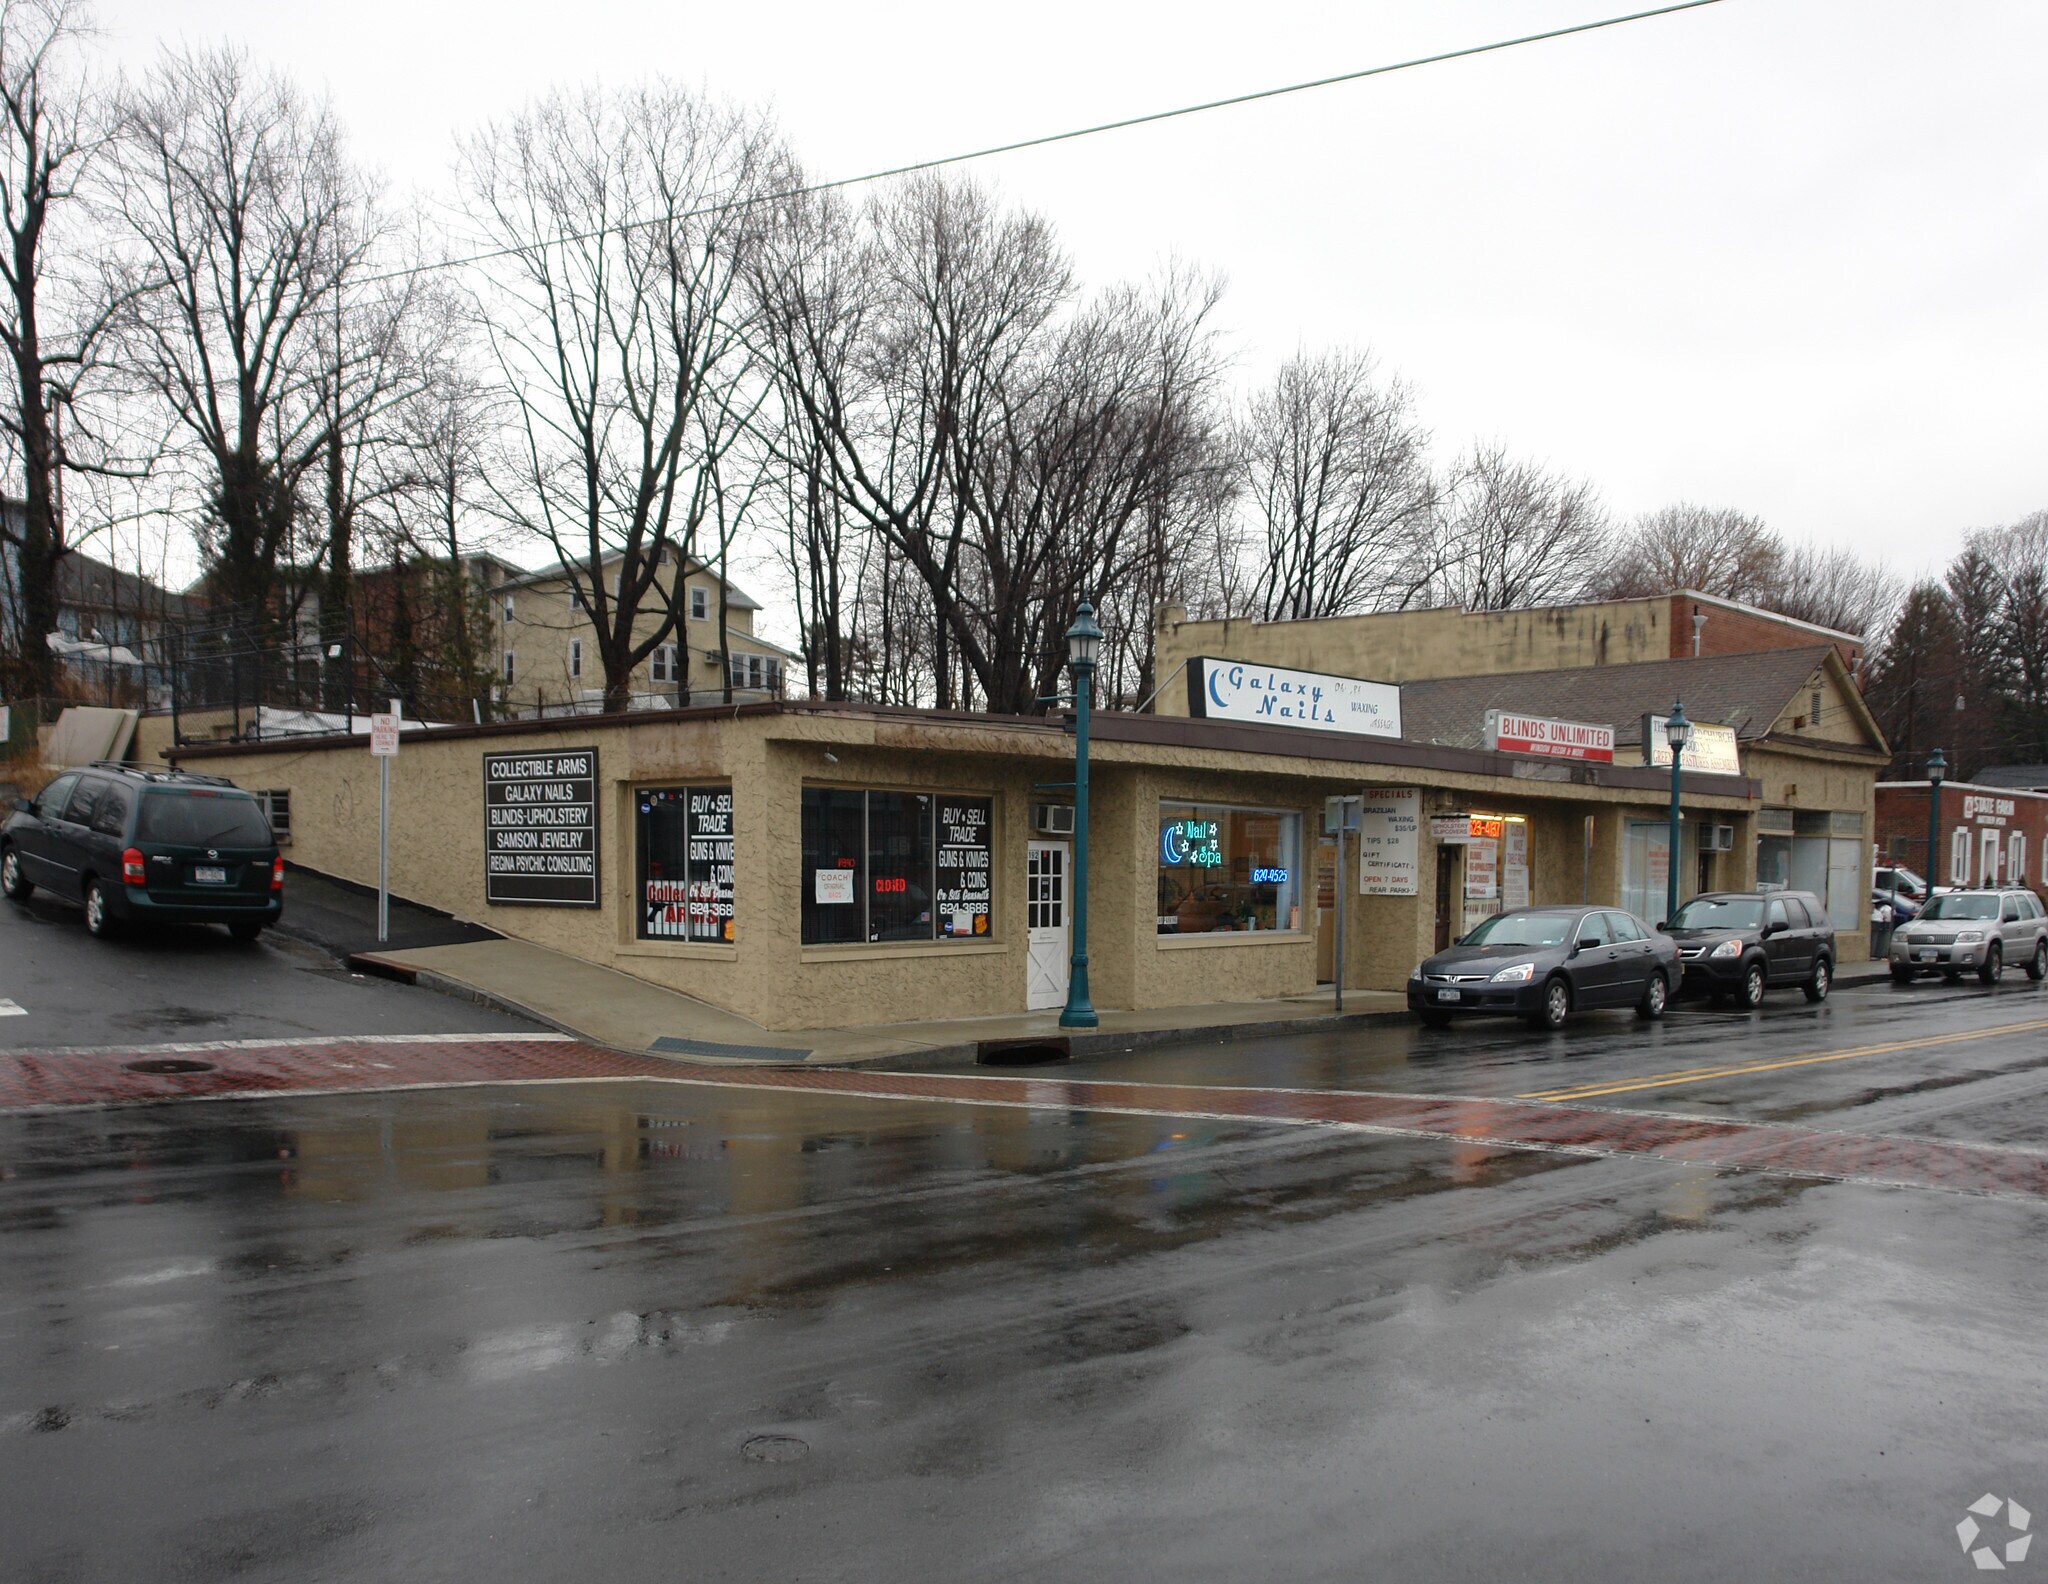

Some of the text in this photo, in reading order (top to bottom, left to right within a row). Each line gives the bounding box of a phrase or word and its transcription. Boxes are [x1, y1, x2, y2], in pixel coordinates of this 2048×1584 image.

[1229, 666, 1323, 703] Galaxy
[1256, 694, 1335, 723] Nails
[1351, 702, 1378, 715] WAXING
[380, 717, 390, 725] NO
[374, 726, 397, 734] PARKING
[1503, 717, 1610, 747] BLINDS UNLIMITED
[1704, 729, 1734, 743] CHURCH
[491, 758, 587, 777] COLLECTIBLE ARMS
[505, 784, 573, 802] GALAXY NAILS
[1369, 790, 1413, 799] SPECIALS
[691, 795, 733, 813] BUY SEL
[1974, 796, 1994, 814] STATE
[491, 807, 588, 825] BLINDS-UPHOLSTERY
[698, 815, 727, 833] TRADE
[943, 808, 986, 825] BUY SELL
[950, 826, 977, 842] TRADE
[1187, 821, 1206, 838] Nail
[497, 832, 583, 848] SAMSON JEWELRY
[690, 842, 734, 860] GUNS & KNIVE
[939, 851, 989, 868] GUNS & KNIVES
[1200, 846, 1221, 868] Spa
[491, 855, 592, 872] REGINA PSYCHIC CONSULTING
[710, 865, 716, 883] &
[960, 872, 987, 888] & COINS
[876, 878, 906, 892] CLOSED
[690, 903, 734, 916] 624-368
[940, 903, 989, 914] 624-3686
